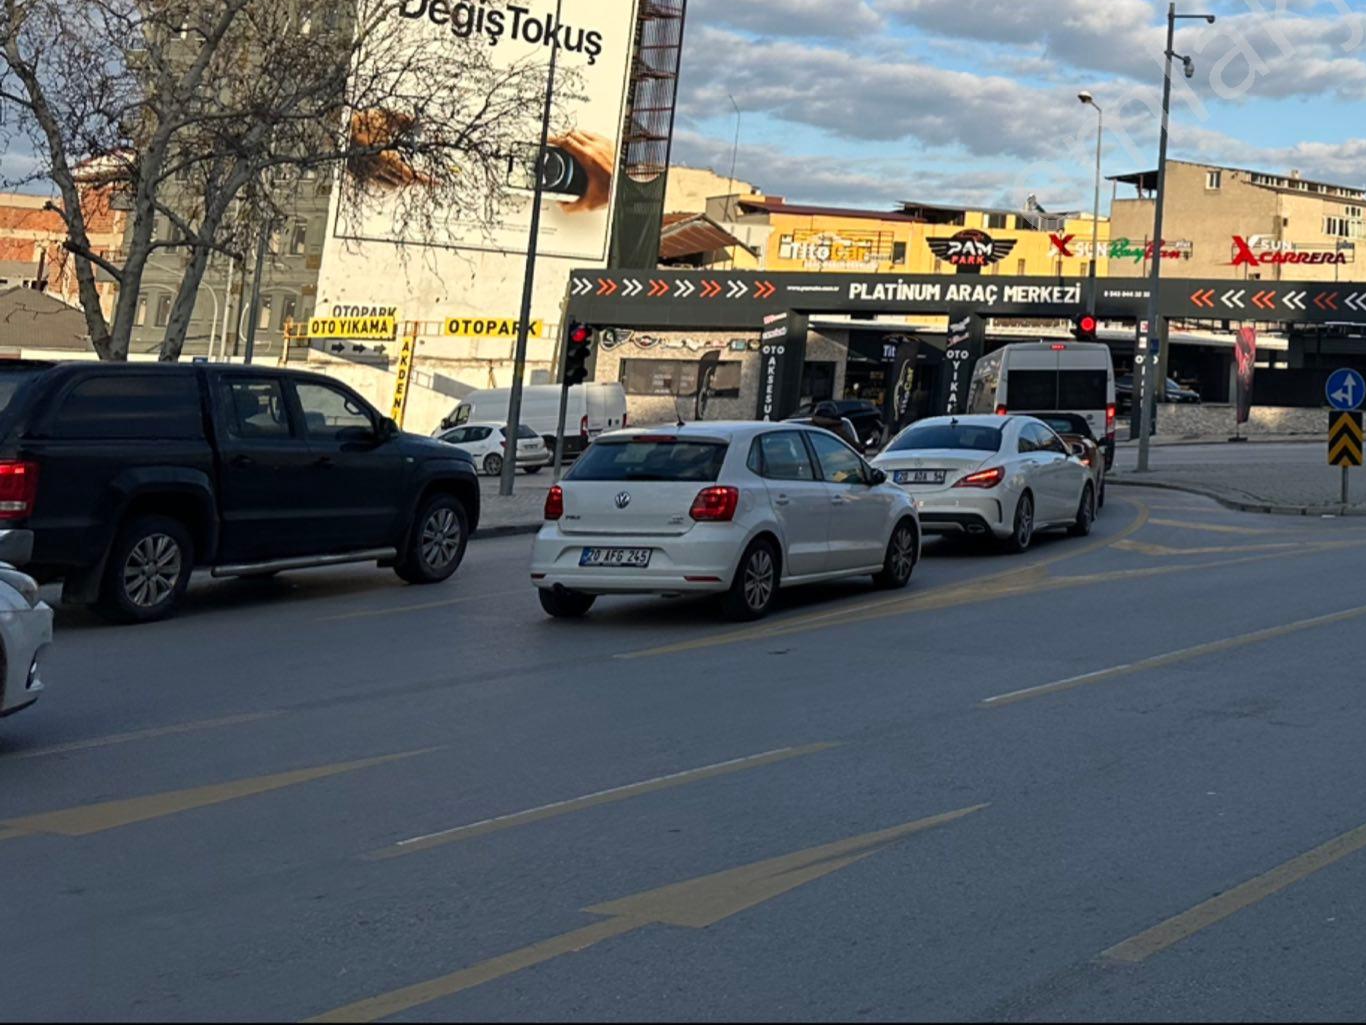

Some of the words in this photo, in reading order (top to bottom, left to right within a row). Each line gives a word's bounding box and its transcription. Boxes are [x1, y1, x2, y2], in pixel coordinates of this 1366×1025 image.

[1260, 239, 1292, 251] SUN
[951, 255, 985, 265] PARK
[1259, 251, 1346, 265] CARRERA
[849, 279, 940, 301] PLATİNUM
[945, 284, 998, 305] ARAÇ
[1003, 282, 1081, 305] MERKEZİ
[312, 320, 335, 333] OTO
[339, 319, 388, 333] YIKAMA
[448, 320, 537, 335] OTOPARK
[762, 345, 785, 355] OTO
[946, 349, 969, 359] OTO
